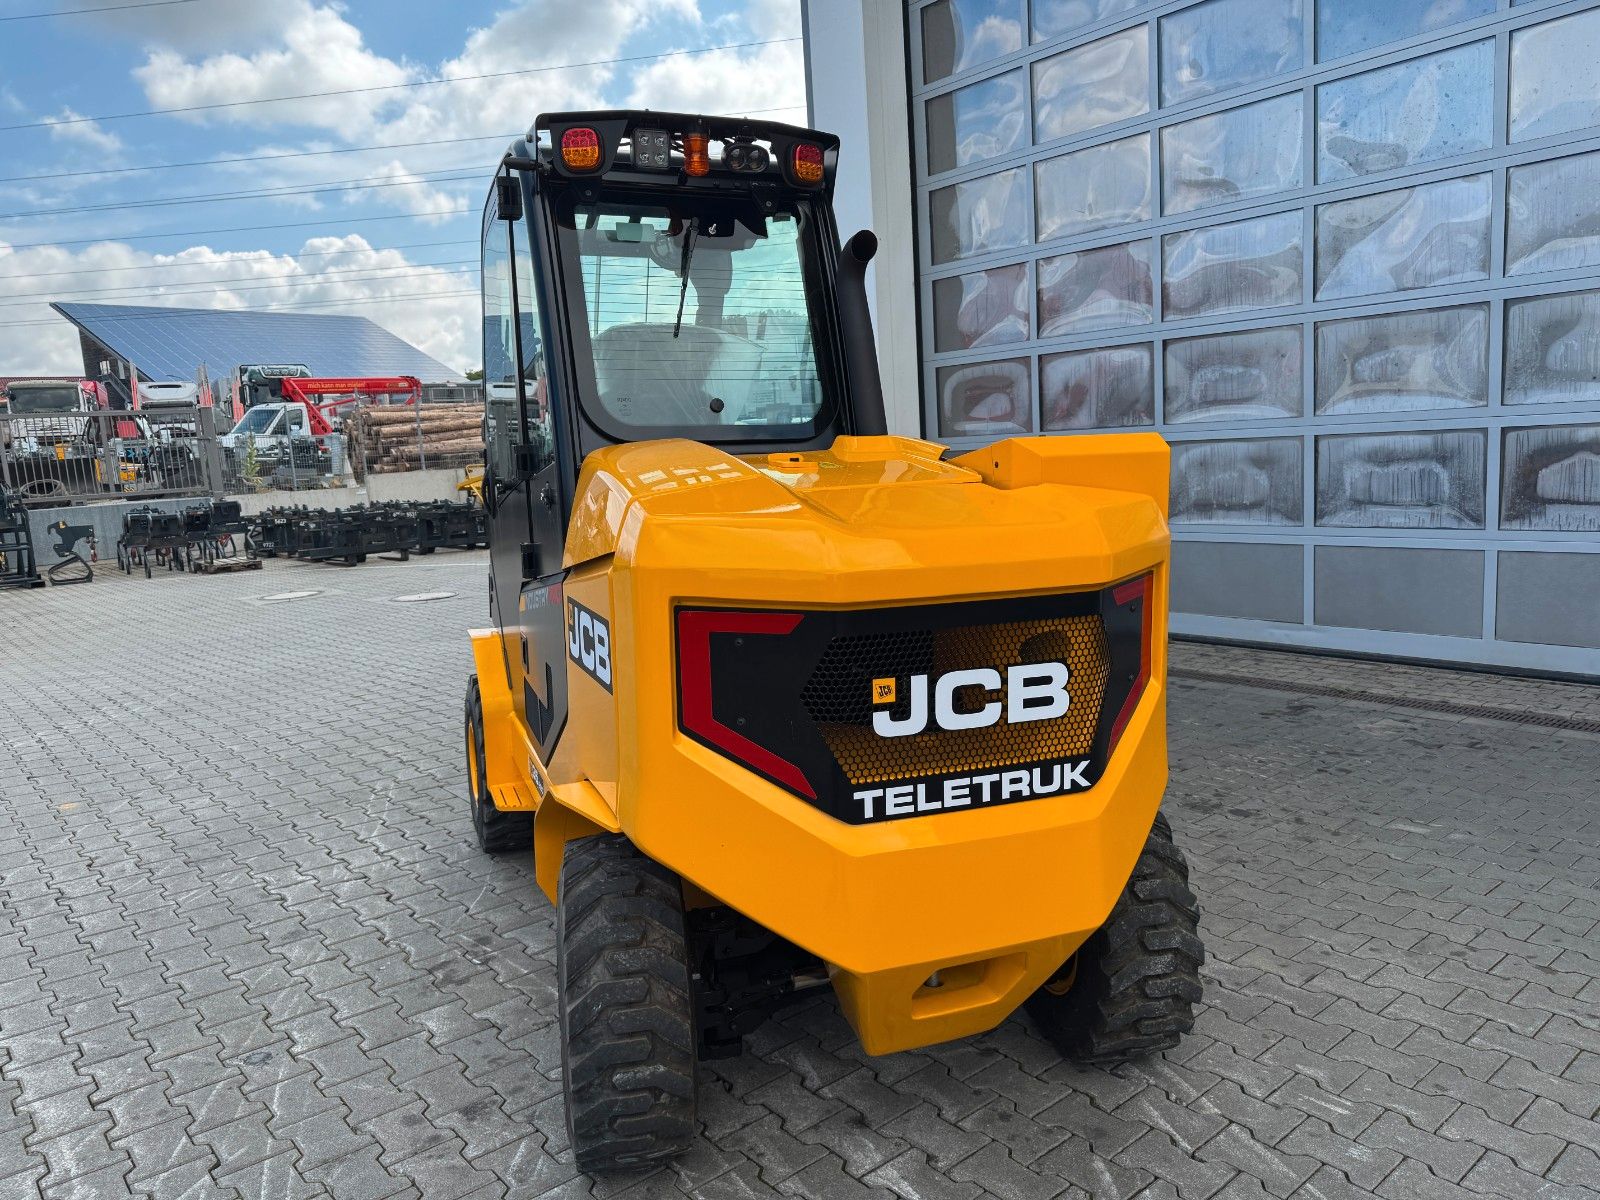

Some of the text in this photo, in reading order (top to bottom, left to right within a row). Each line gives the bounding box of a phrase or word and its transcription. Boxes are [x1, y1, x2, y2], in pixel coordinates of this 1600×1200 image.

[569, 606, 611, 685] JCB
[872, 662, 1070, 737] JCB
[853, 760, 1091, 819] TELETRUK
